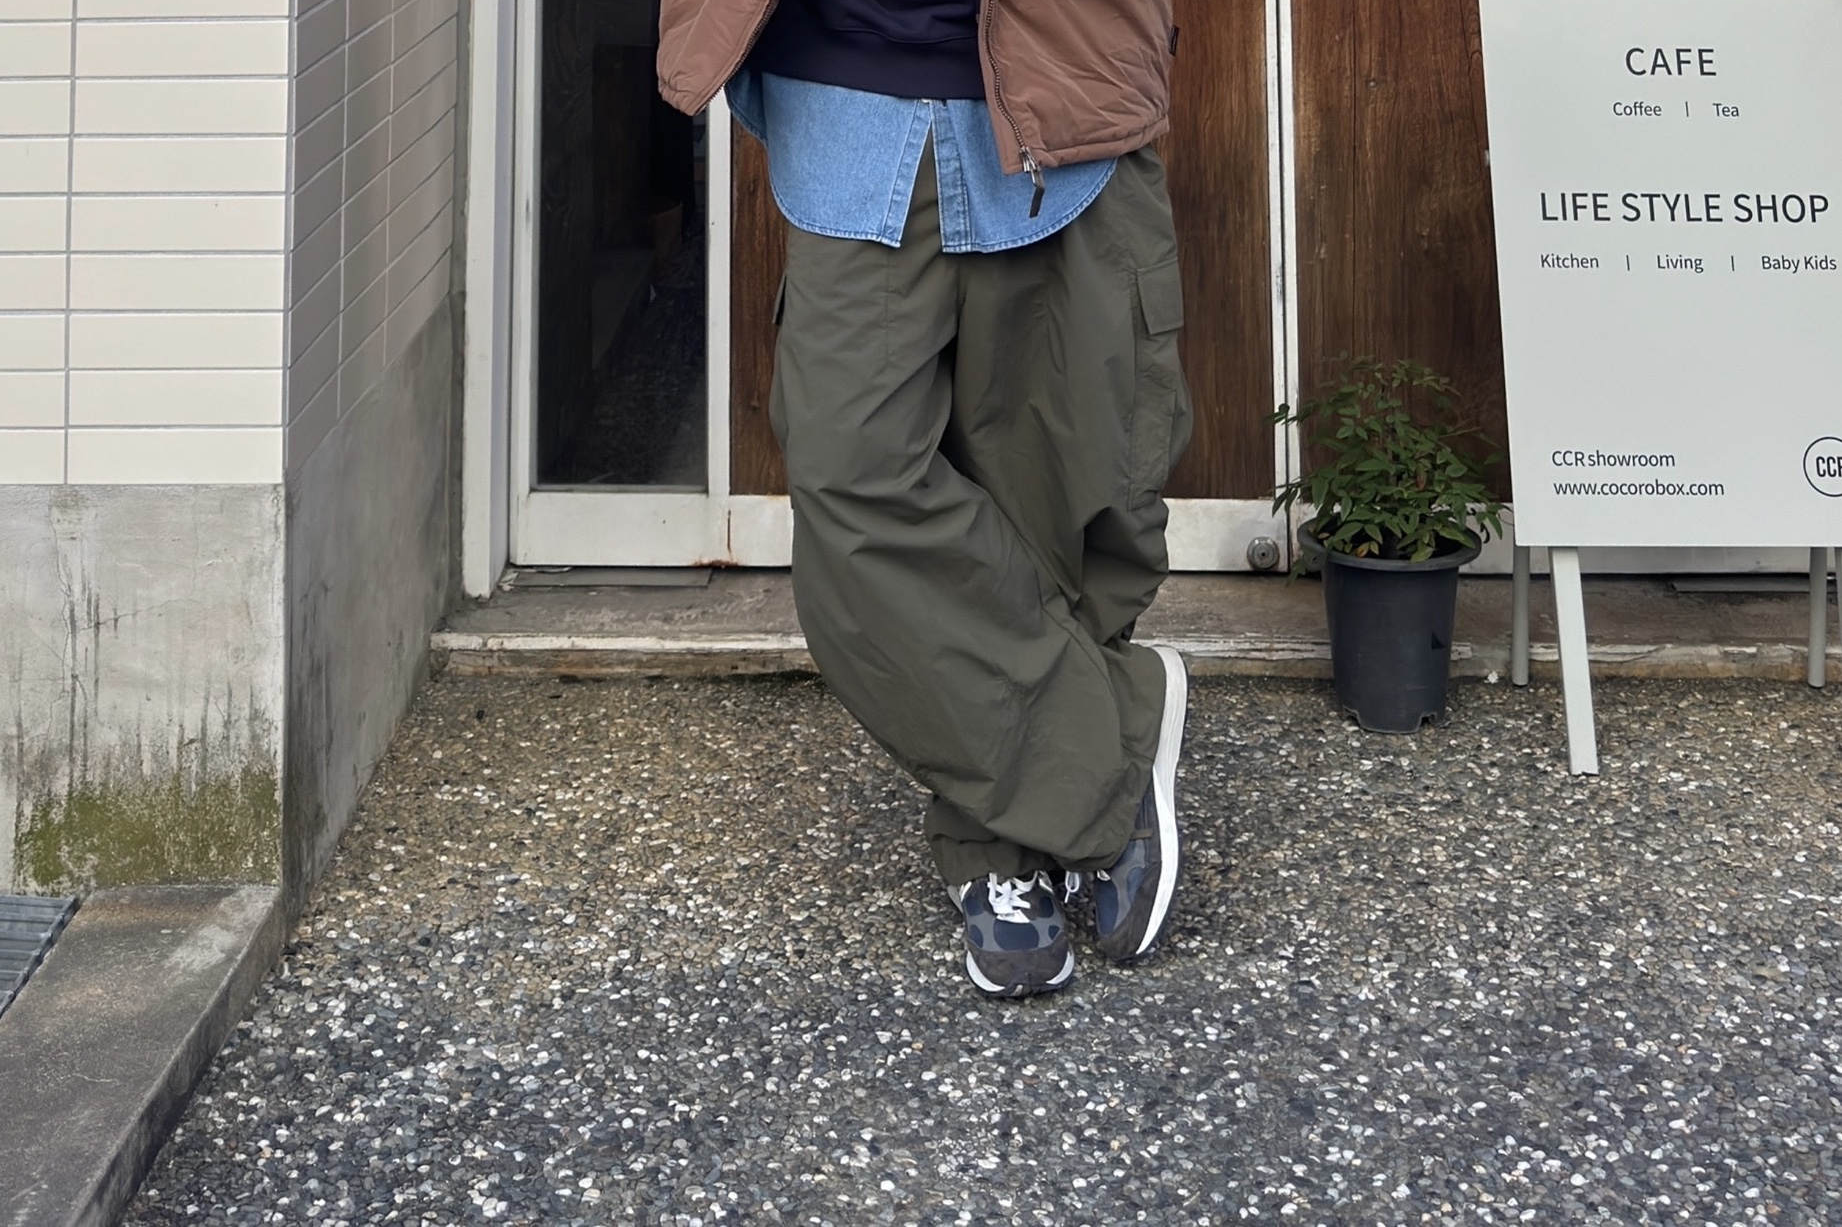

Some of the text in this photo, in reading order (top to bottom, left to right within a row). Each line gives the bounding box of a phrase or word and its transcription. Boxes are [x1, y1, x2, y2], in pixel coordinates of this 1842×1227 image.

[1625, 47, 1717, 77] CAFE
[1612, 101, 1740, 118] Coffee Tea
[1540, 192, 1829, 224] LIFE STYLE SHOP
[1540, 253, 1837, 274] Kitchen Living Baby Kids
[1553, 478, 1725, 496] www.cocorobox.com
